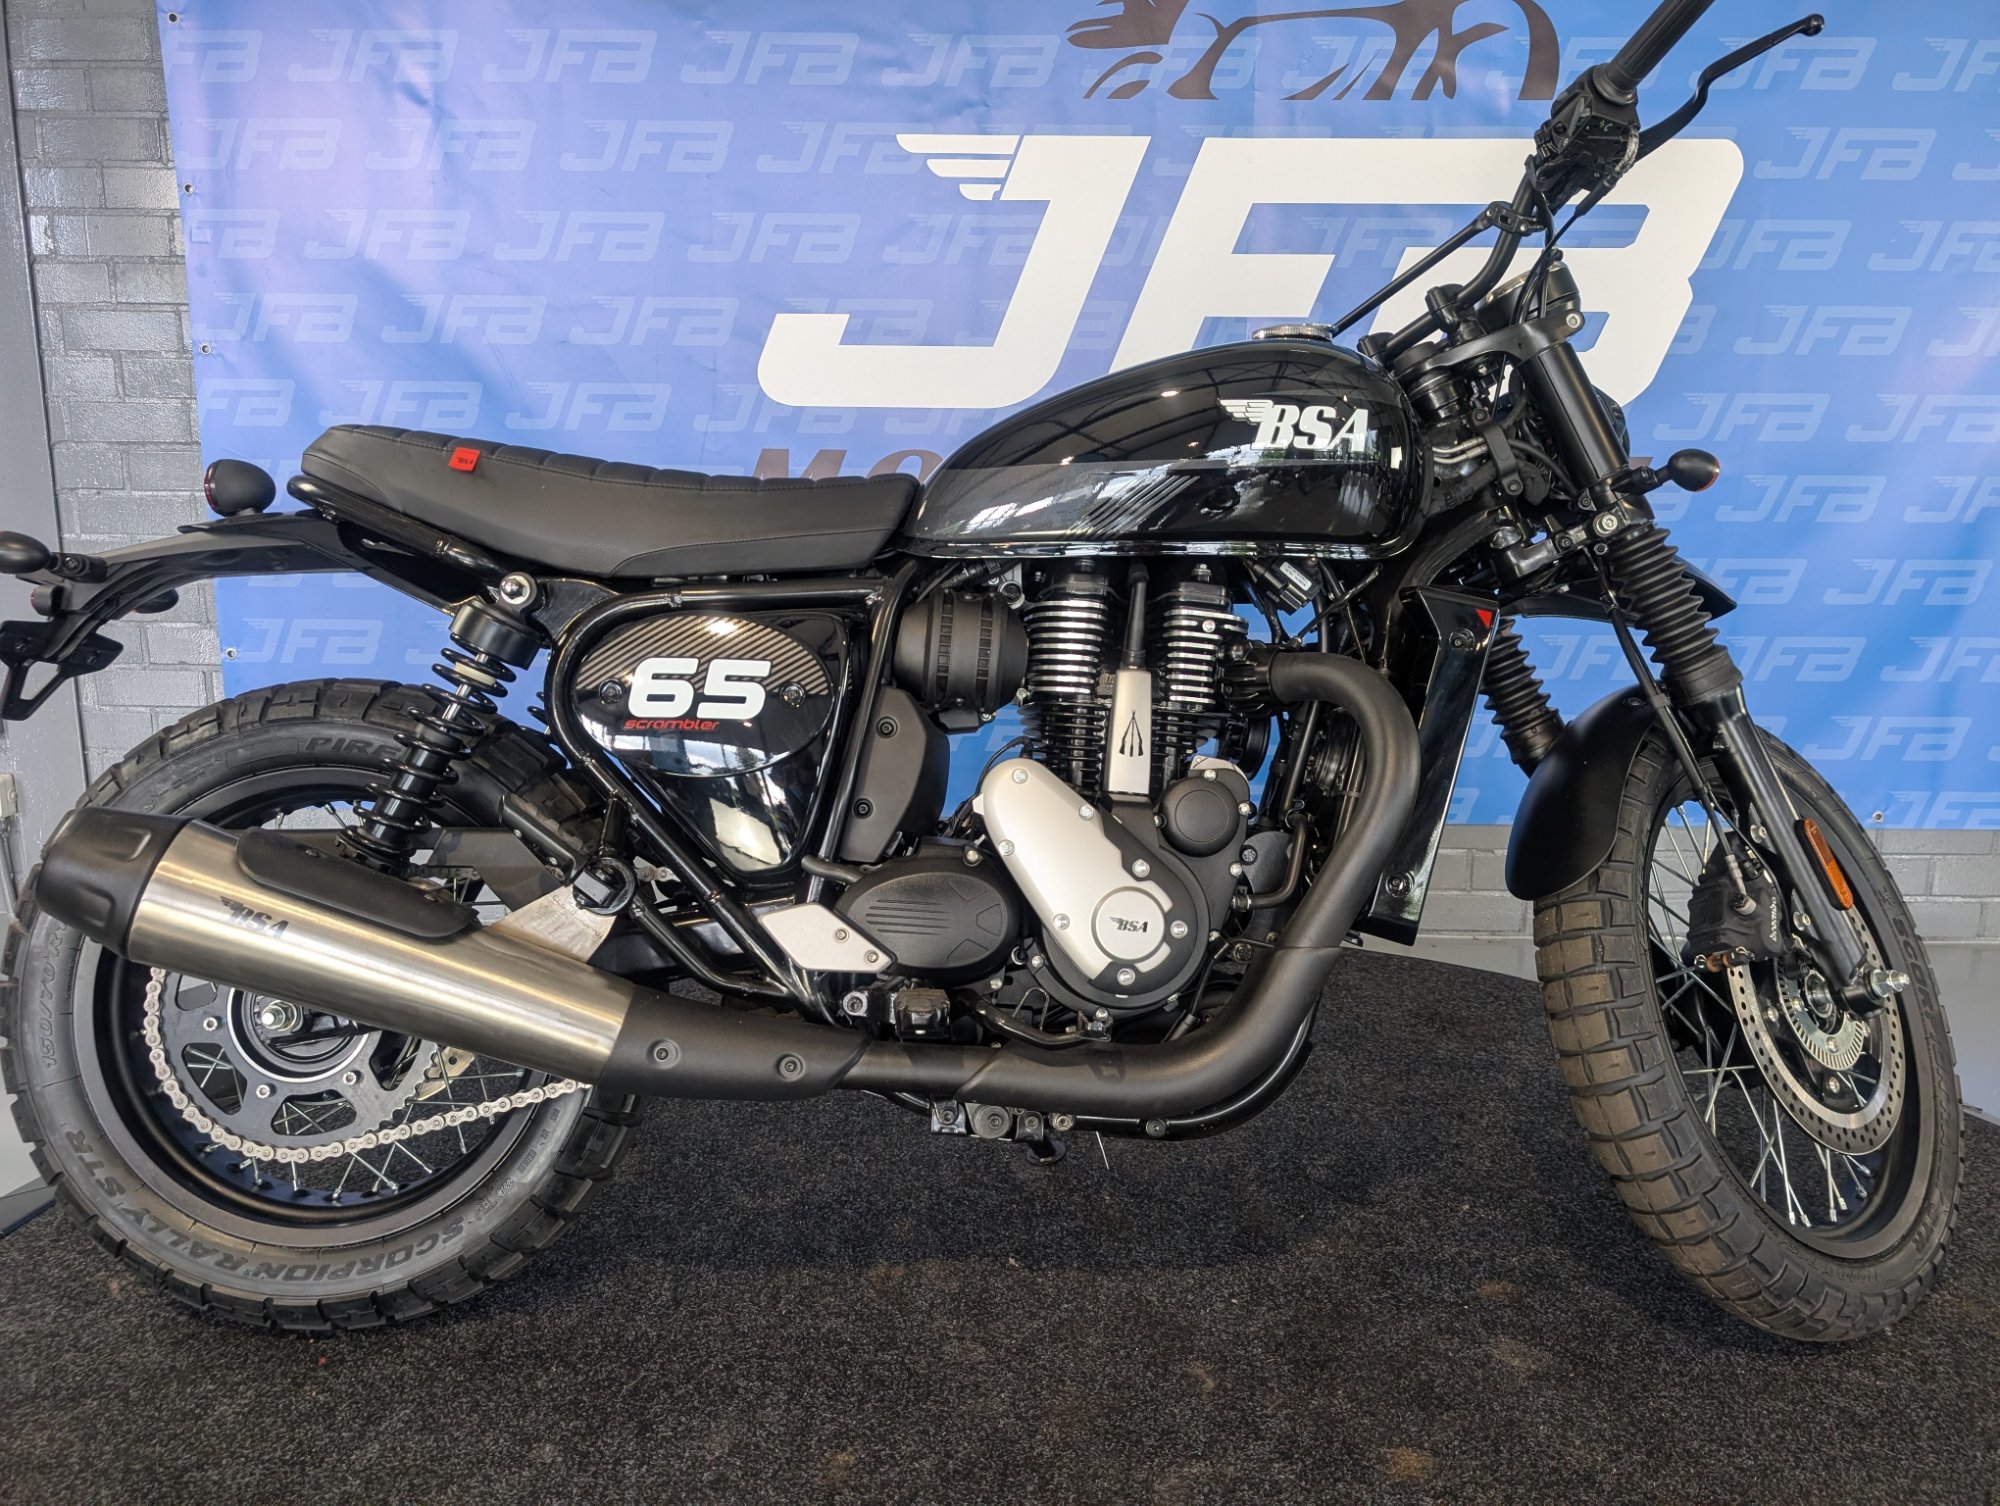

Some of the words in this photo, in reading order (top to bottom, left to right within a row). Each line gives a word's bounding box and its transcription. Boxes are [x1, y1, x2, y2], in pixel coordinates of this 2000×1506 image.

[162, 29, 263, 83] FB
[287, 29, 459, 82] JFB
[482, 29, 658, 83] JFB
[680, 31, 860, 85] JFB
[881, 33, 1061, 87] JFB
[1892, 37, 2000, 92] JF
[178, 118, 342, 170] JFB
[366, 118, 537, 171] JFB
[559, 119, 735, 172] JFB
[1753, 127, 1936, 180] JFB
[304, 209, 471, 260] JFB
[493, 210, 665, 262] JFB
[687, 212, 862, 263] JFB
[757, 134, 1743, 410] JFB
[191, 292, 358, 342] JFB
[381, 294, 546, 344] JFB
[569, 296, 739, 346] JFB
[1733, 305, 1913, 356] JFB
[199, 378, 296, 427] FB
[318, 380, 483, 428] JFB
[505, 382, 672, 431] JFB
[1653, 393, 1831, 442] JFB
[1251, 404, 1369, 452] BSA
[1715, 475, 1887, 523] JFB
[1903, 476, 2000, 523] JF
[1687, 558, 1808, 605] FB
[1824, 559, 1993, 606] JFB
[236, 618, 383, 665] JFB
[628, 657, 771, 720] 65
[305, 736, 402, 758] PIRE
[624, 719, 720, 731] scrambler
[1801, 716, 1973, 762] JFB
[1116, 918, 1149, 933] BSA
[65, 1130, 126, 1198] STR
[118, 1207, 248, 1272] RALLY
[252, 1216, 464, 1282] SCORPION
